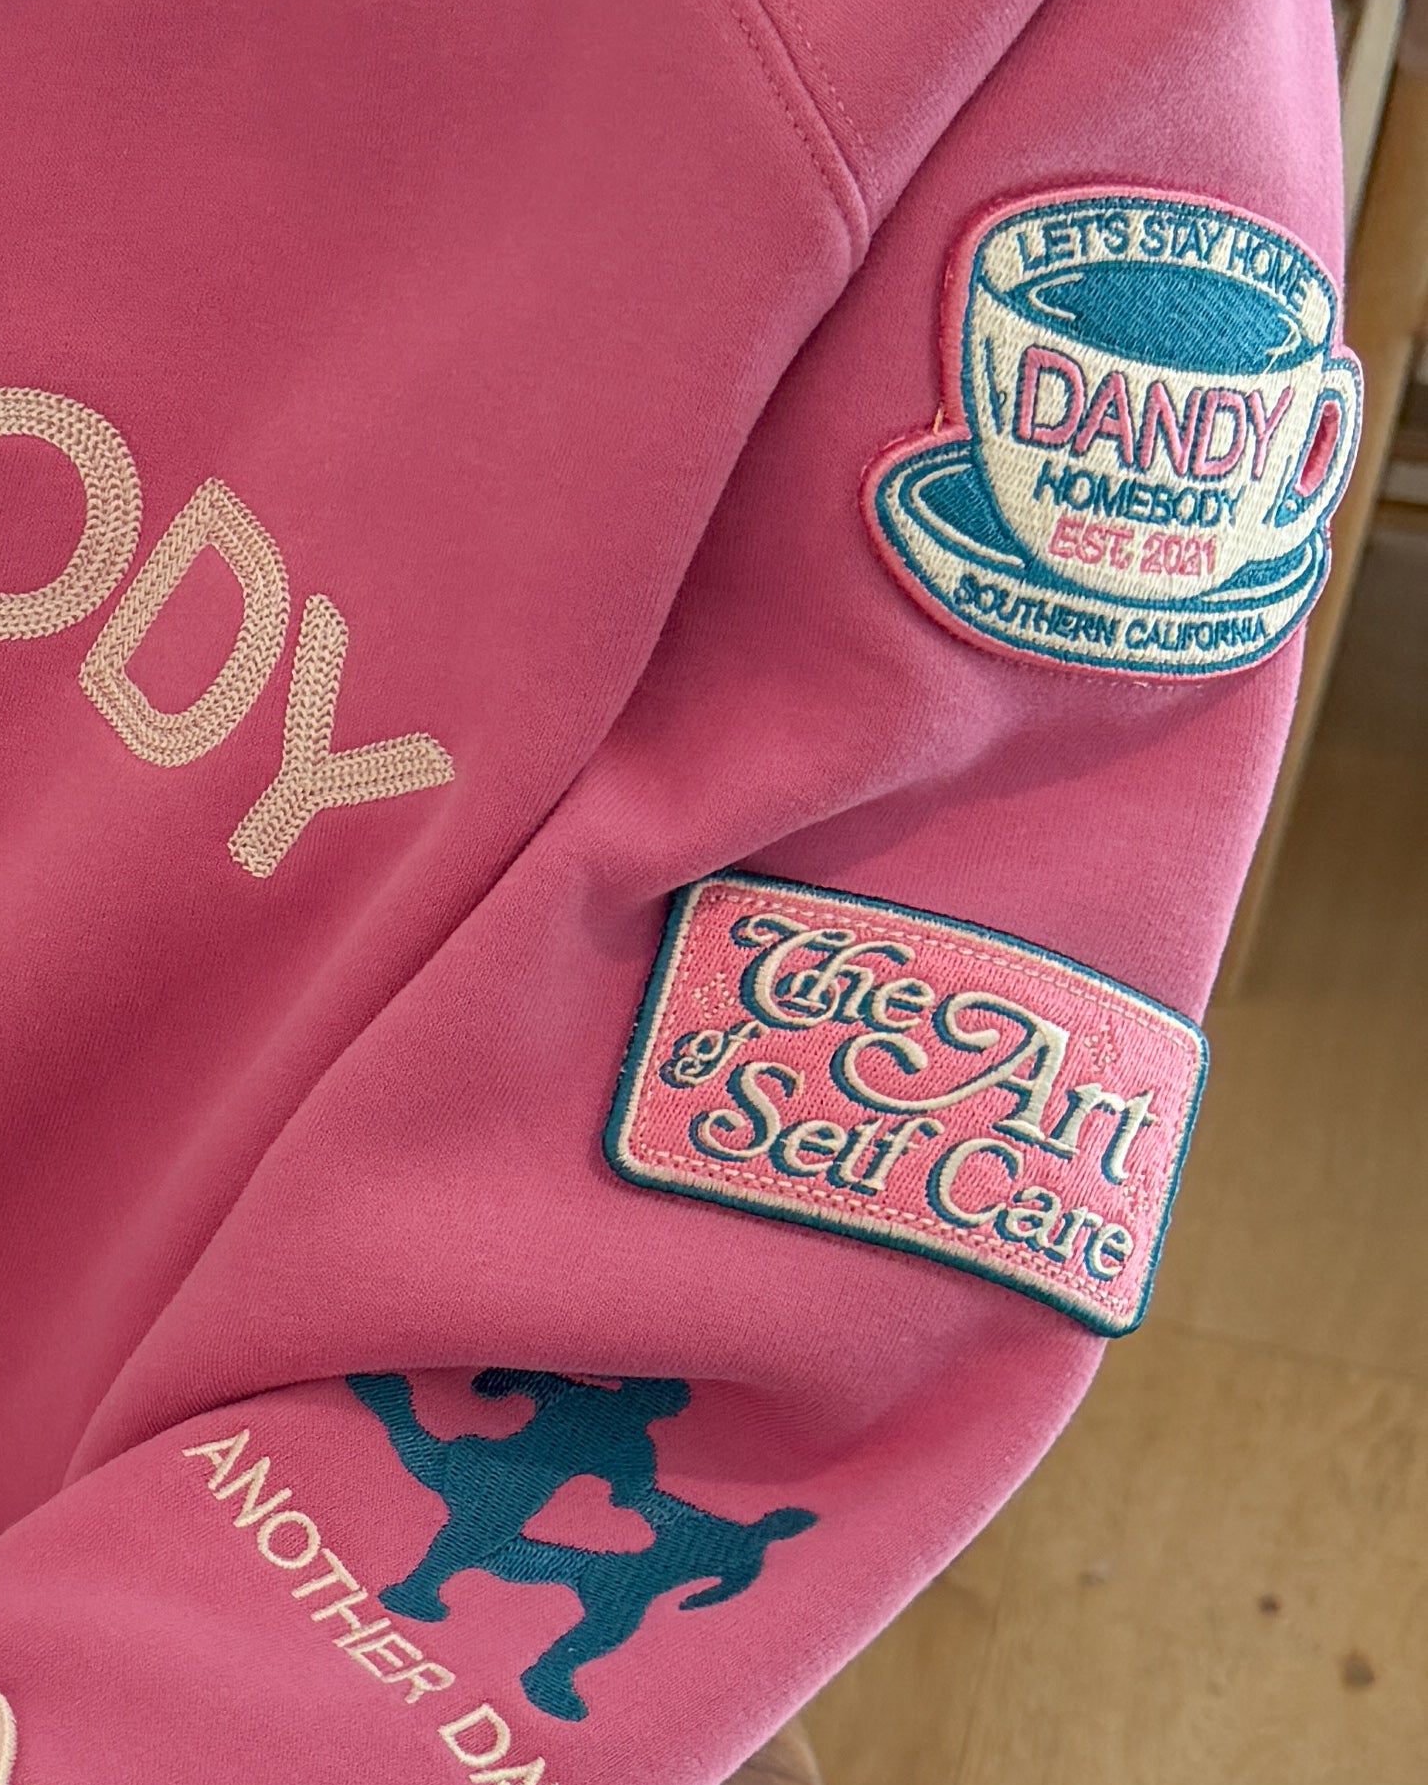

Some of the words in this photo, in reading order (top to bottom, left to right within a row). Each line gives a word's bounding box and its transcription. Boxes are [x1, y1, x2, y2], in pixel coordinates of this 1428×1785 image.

[1139, 212, 1225, 262] STAY
[1231, 235, 1316, 311] HOME
[1012, 346, 1295, 482] DANDY
[1034, 460, 1244, 528] HOMEBODY
[1141, 532, 1216, 577] 2021
[953, 573, 1116, 648] SOUTHERN
[1126, 616, 1268, 651] CALIFORNIA
[732, 913, 934, 1030] The
[659, 1023, 764, 1089] of
[830, 990, 1155, 1185] Art
[688, 1061, 942, 1194] Self
[927, 1137, 1135, 1281] Care
[182, 1429, 456, 1705] ANOTHER
